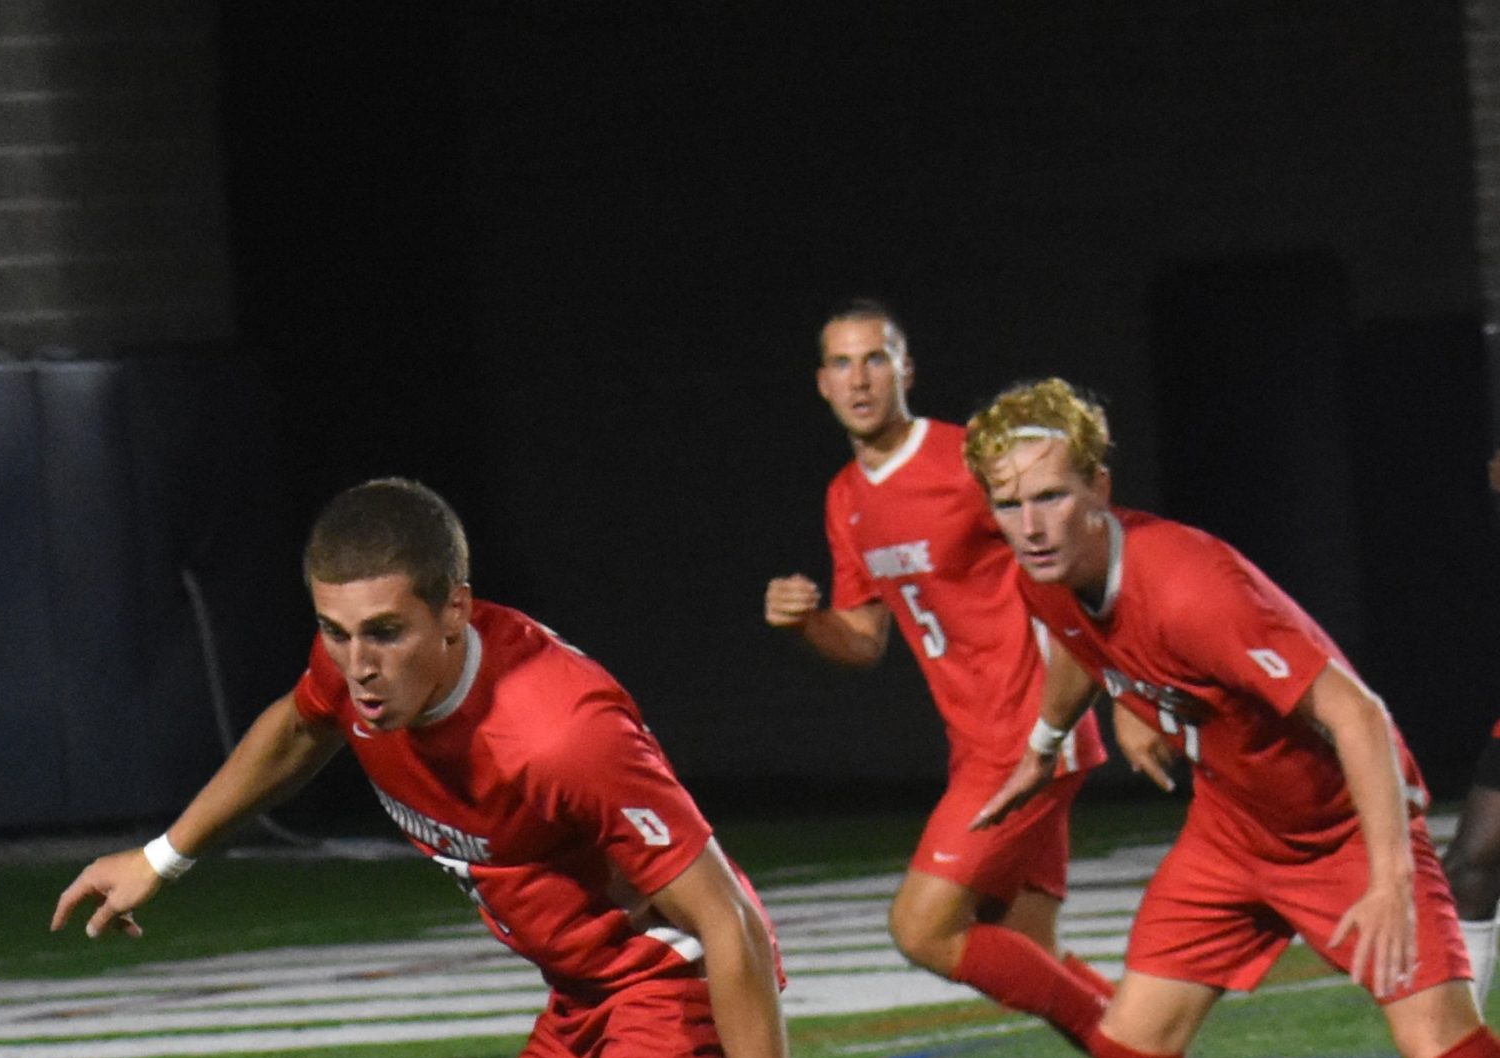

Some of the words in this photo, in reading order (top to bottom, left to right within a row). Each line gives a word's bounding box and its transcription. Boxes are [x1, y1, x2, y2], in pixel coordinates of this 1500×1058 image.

[900, 584, 947, 659] 5
[1246, 648, 1291, 679] D
[620, 807, 671, 846] D
